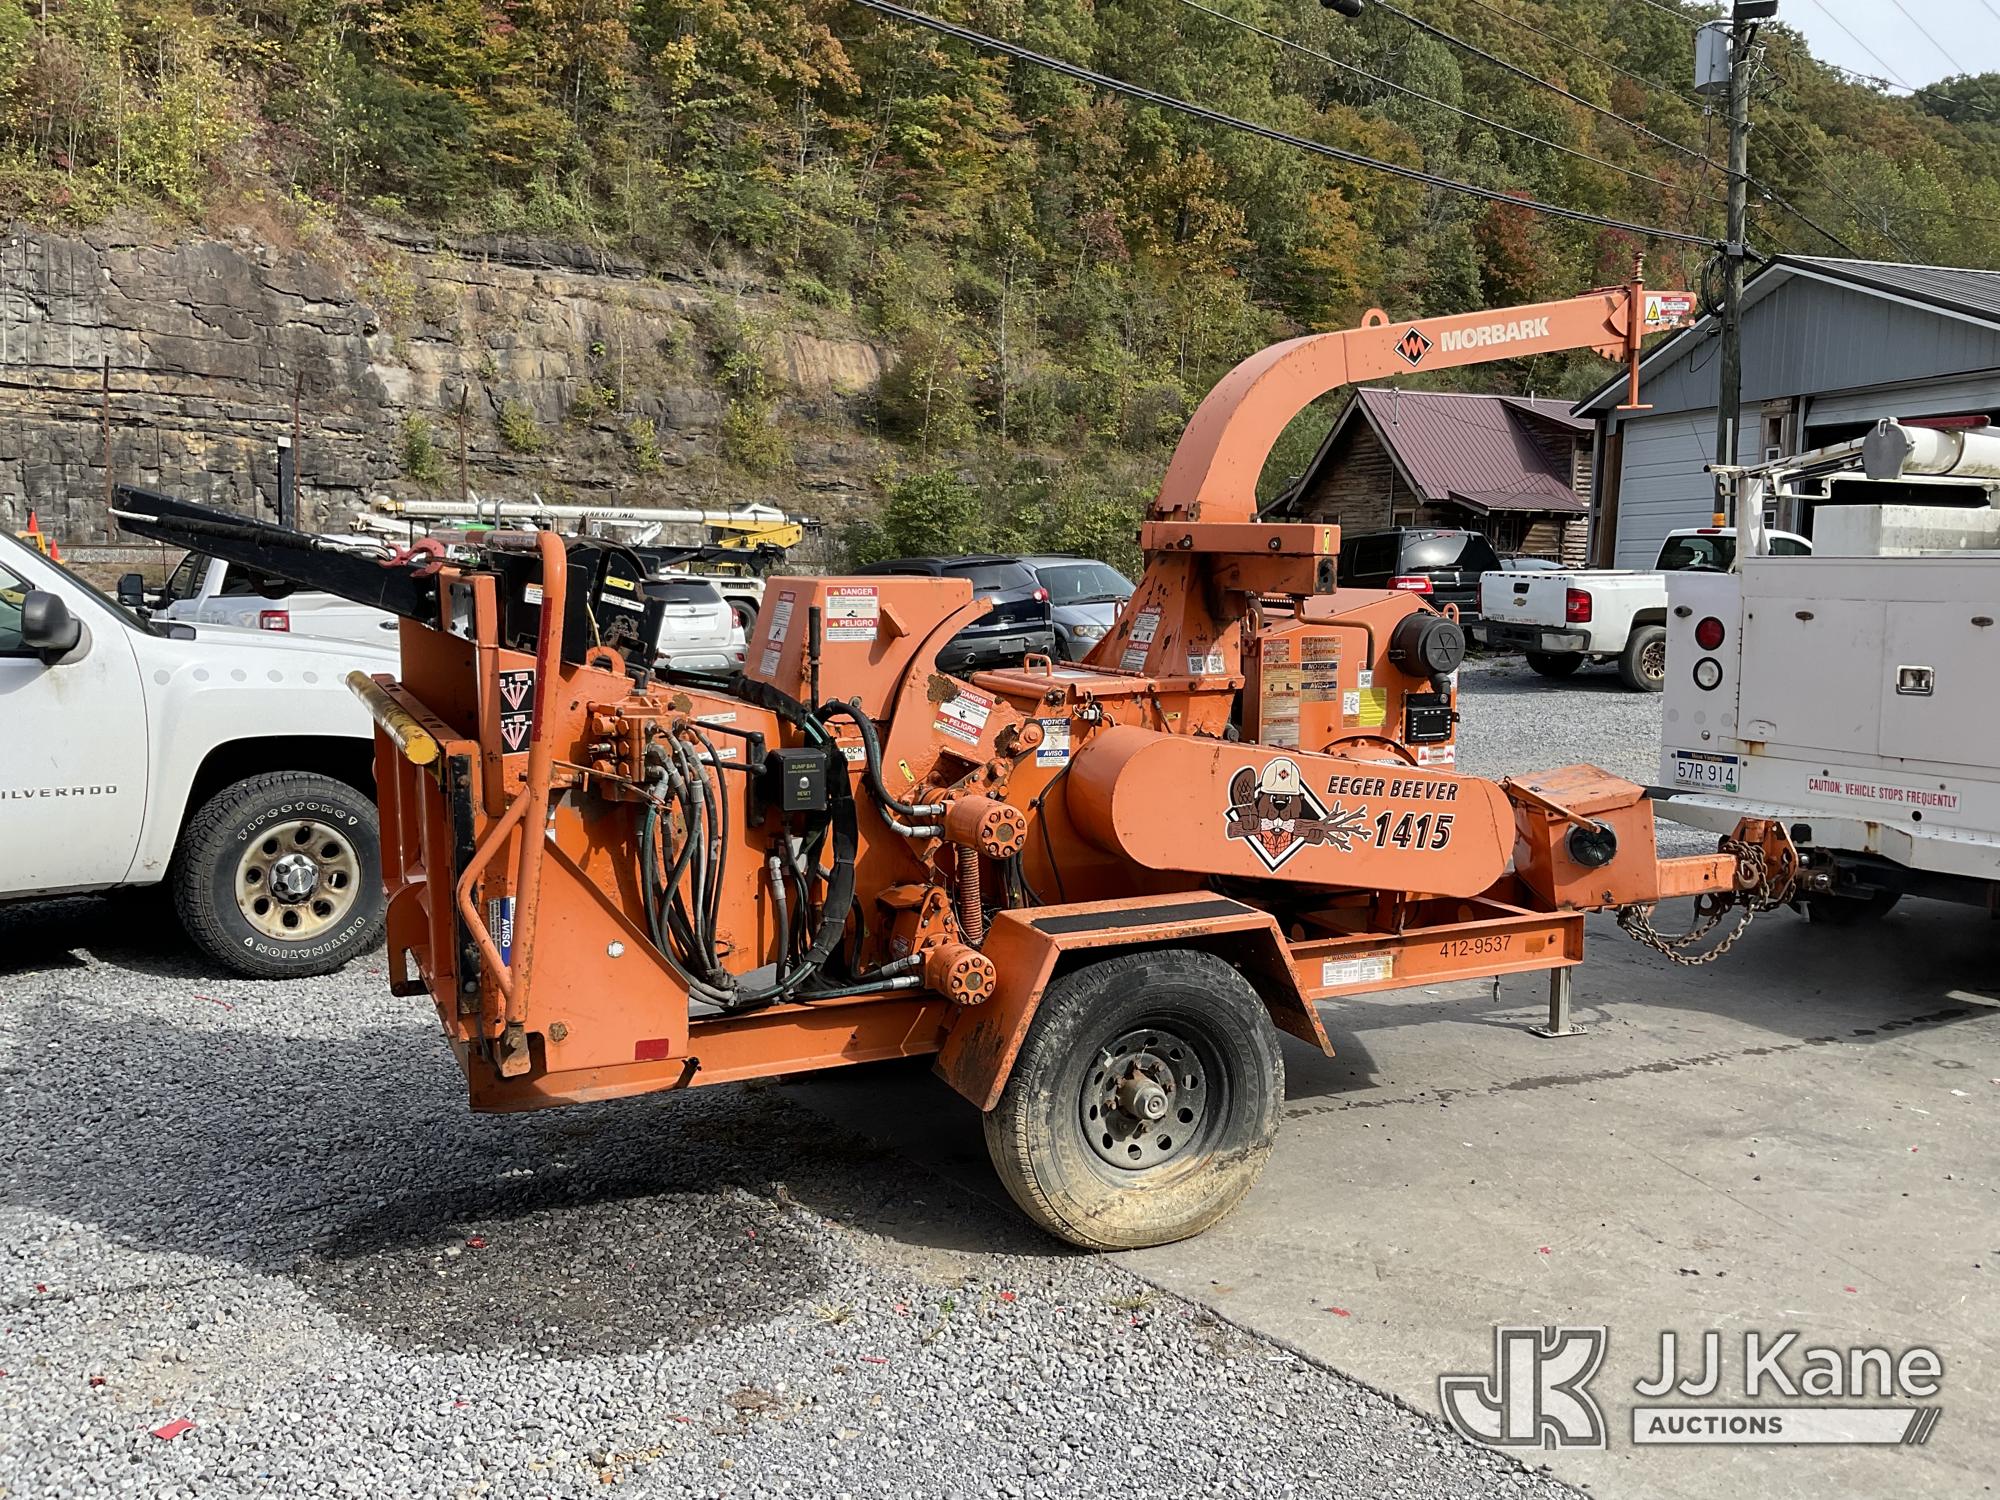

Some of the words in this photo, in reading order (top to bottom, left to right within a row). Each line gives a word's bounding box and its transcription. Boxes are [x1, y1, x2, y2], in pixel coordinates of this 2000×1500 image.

[1440, 317, 1550, 352] MORBARK
[840, 588, 873, 596] DANGER
[840, 619, 874, 627] PELIGRO
[960, 690, 988, 706] DANGER
[948, 717, 977, 734] PELIGRO
[1041, 718, 1067, 726] NOTICE
[1678, 762, 1703, 780] 57R
[1708, 765, 1733, 783] 914
[1, 785, 118, 799] ILVERADO
[1327, 775, 1386, 797] EEGER
[1389, 779, 1459, 801] BEEVER
[1809, 778, 1842, 794] CAUTION:
[1845, 783, 1876, 798] VEHICLE
[1879, 787, 1904, 802] STOPS
[1906, 791, 1957, 808] FREQUENTLY
[1375, 811, 1455, 850] 1415
[255, 916, 366, 959] DESTINATION
[501, 918, 511, 948] AVISO
[1440, 936, 1512, 959] 412-9537
